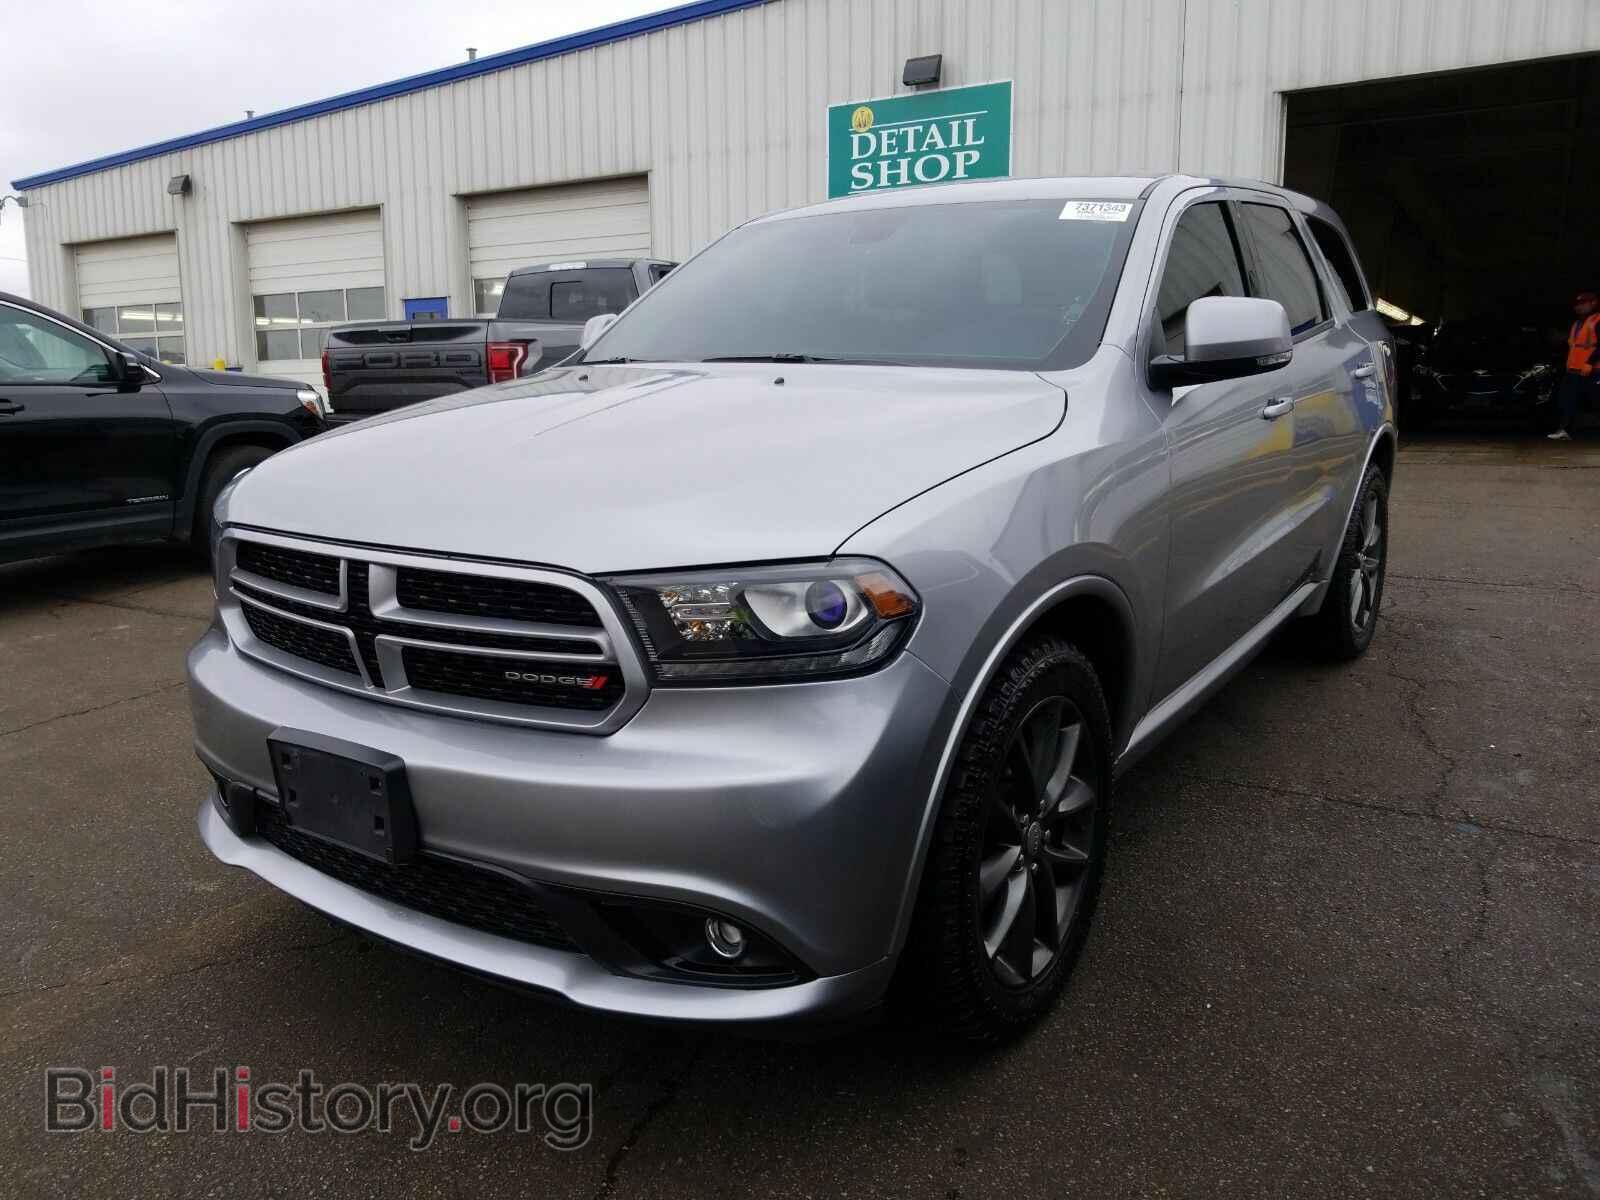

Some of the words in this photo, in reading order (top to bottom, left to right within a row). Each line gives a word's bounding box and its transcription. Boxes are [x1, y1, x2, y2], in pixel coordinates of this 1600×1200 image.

[850, 119, 985, 160] DETAIL
[850, 150, 980, 190] SHOP
[333, 351, 481, 369] FORD
[504, 671, 593, 686] DODGE
